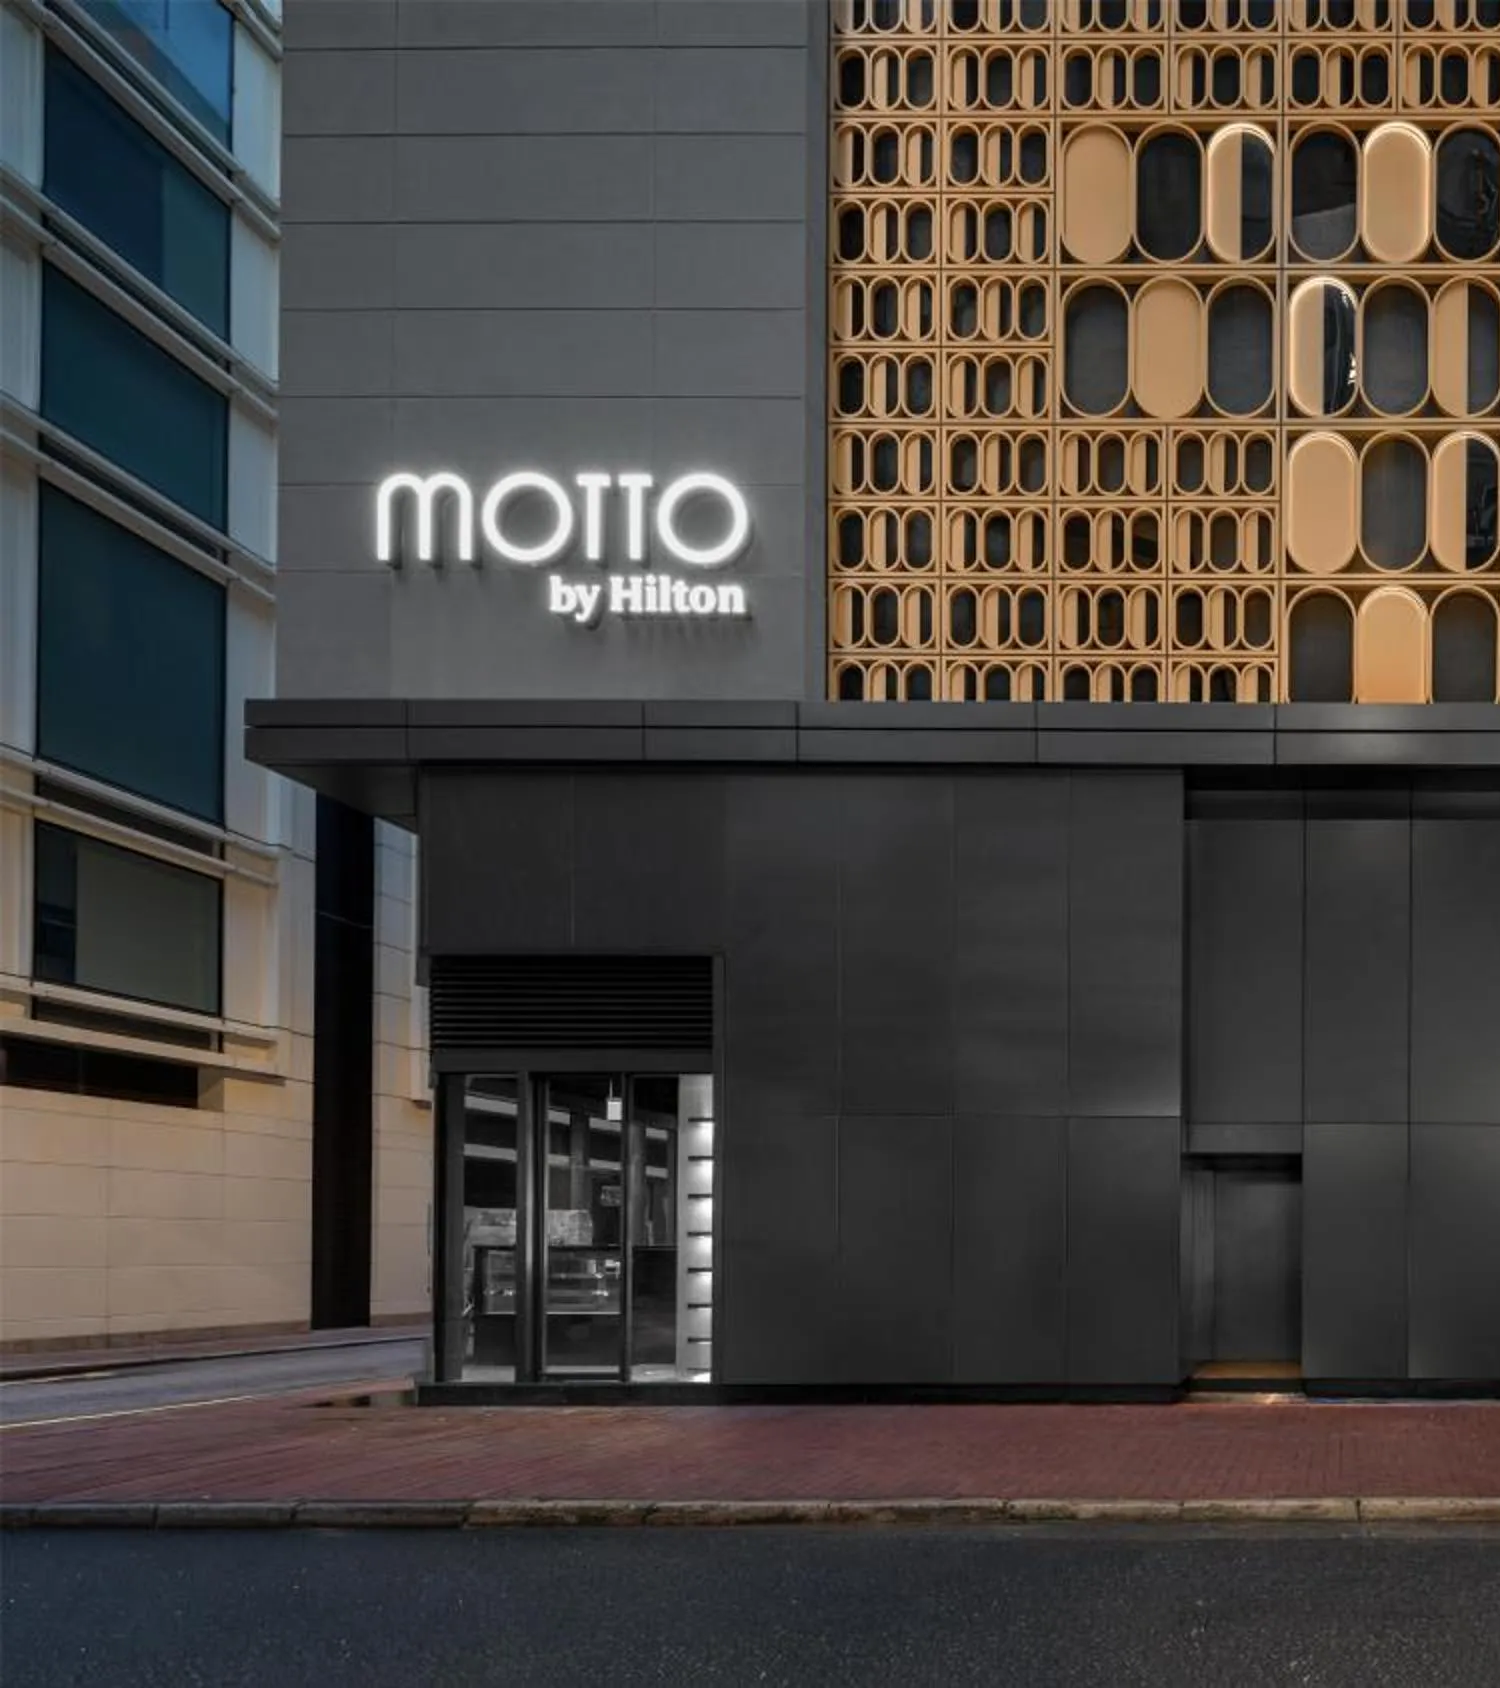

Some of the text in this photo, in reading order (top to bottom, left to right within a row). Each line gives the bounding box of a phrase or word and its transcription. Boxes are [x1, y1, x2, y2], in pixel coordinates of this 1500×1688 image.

[376, 471, 749, 564] MOTTO
[549, 574, 746, 622] by Hilton
